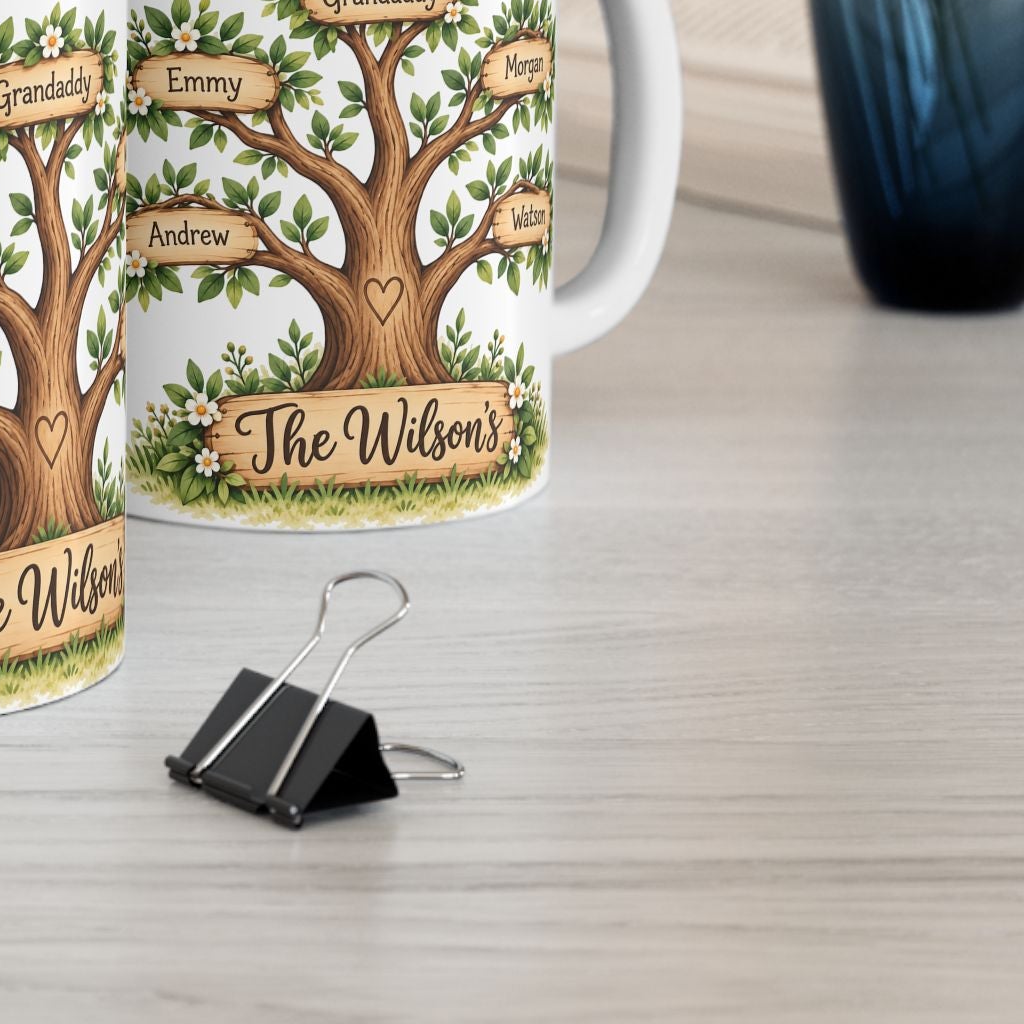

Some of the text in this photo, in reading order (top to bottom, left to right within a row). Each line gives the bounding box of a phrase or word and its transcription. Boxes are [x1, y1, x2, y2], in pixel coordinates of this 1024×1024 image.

[505, 53, 544, 83] Morgan
[166, 67, 243, 102] Emmy
[511, 203, 546, 231] Watson
[148, 219, 230, 248] Andrew
[234, 396, 504, 475] The Wilson's
